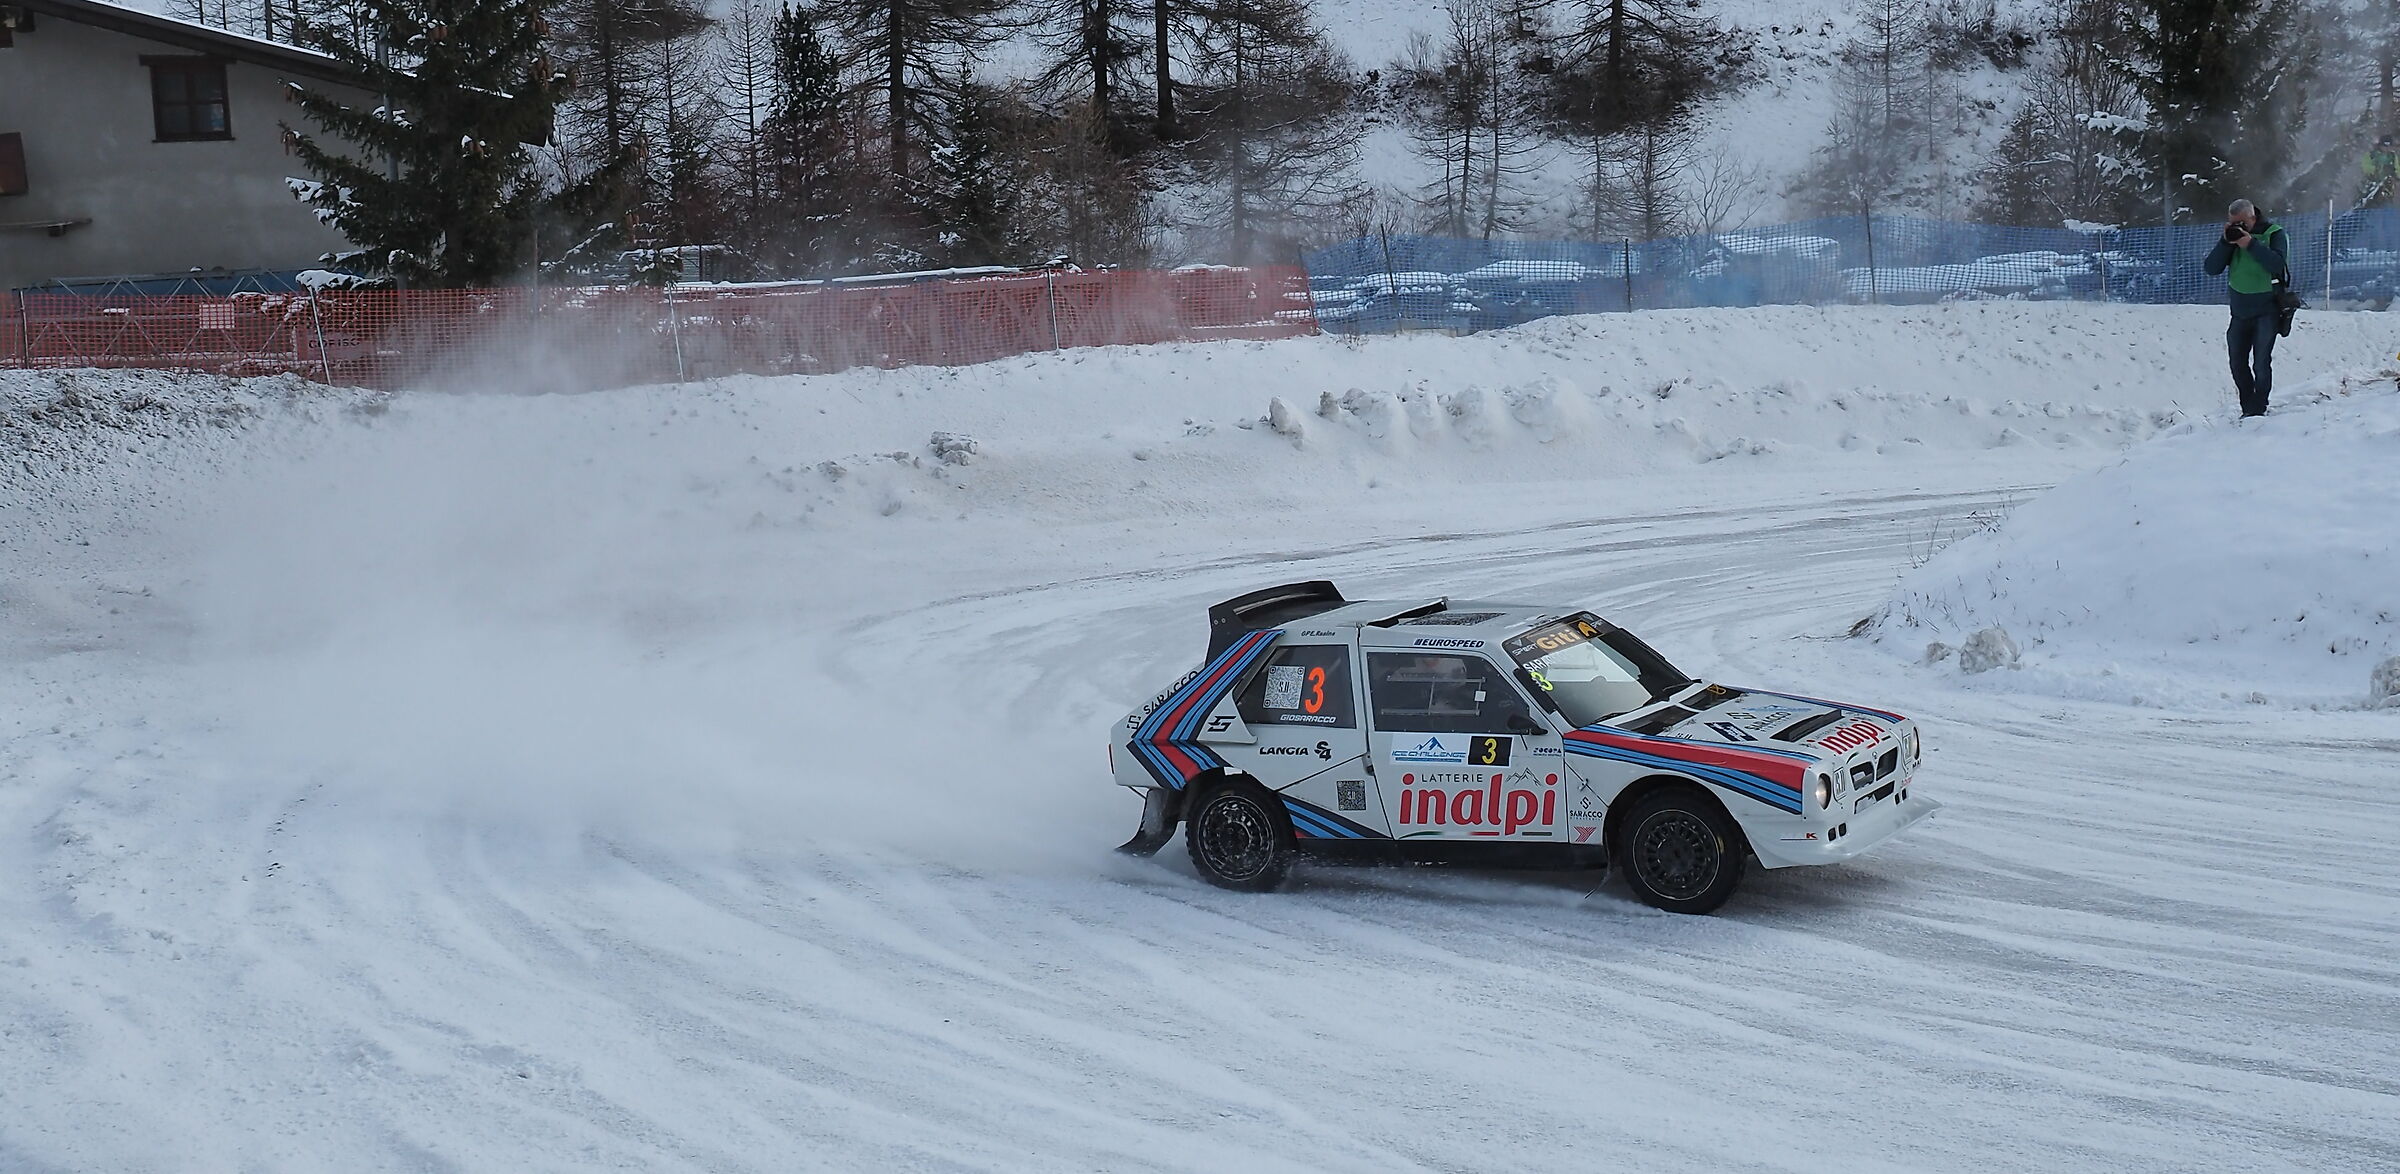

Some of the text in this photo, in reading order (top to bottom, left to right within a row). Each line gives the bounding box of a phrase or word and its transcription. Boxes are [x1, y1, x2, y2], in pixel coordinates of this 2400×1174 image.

[1421, 638, 1485, 648] EUROSPEED
[1536, 629, 1581, 650] Giti
[1305, 667, 1325, 714] 3
[1530, 671, 1554, 691] 3
[1259, 746, 1309, 756] LANCIA
[1482, 738, 1497, 764] 3
[1421, 773, 1484, 783] LATTERIE
[1399, 773, 1559, 836] inalpi
[1569, 809, 1603, 818] SARACCO
